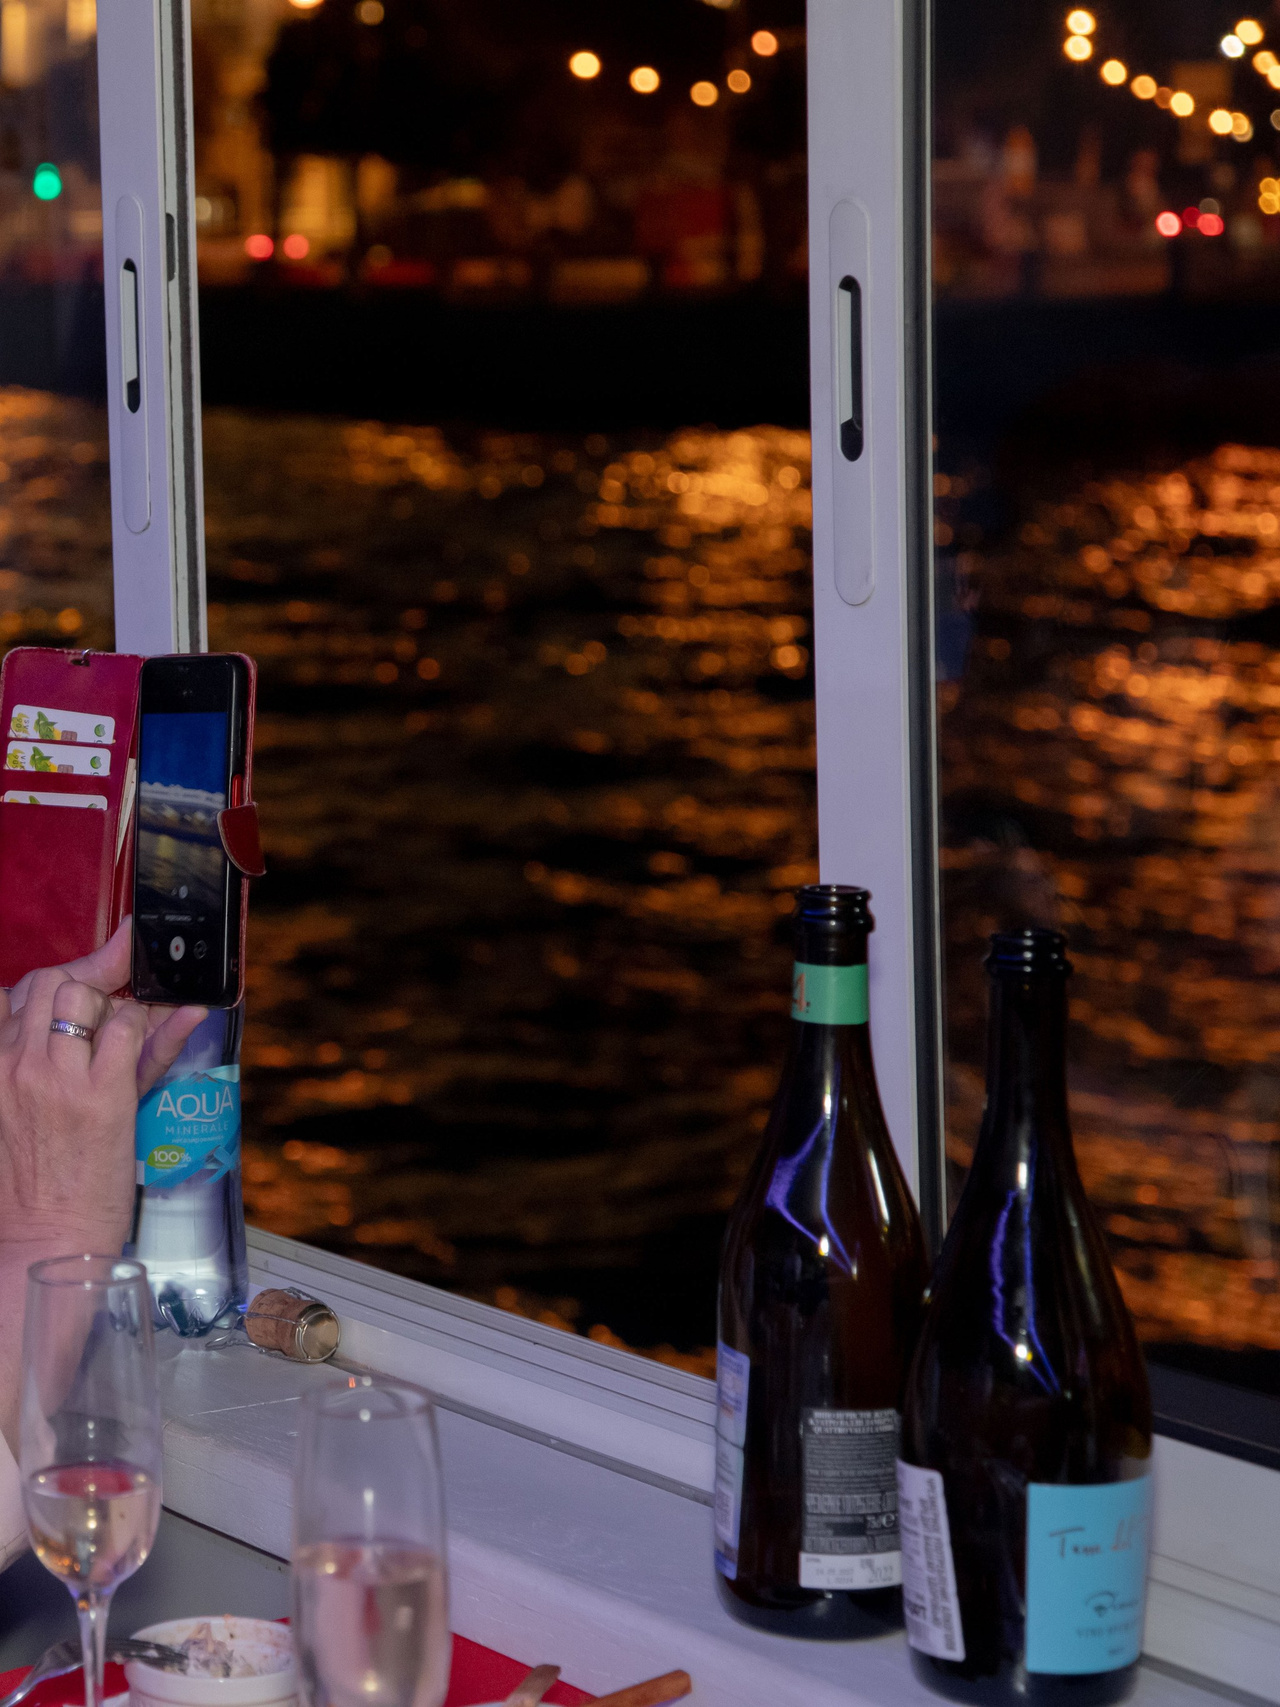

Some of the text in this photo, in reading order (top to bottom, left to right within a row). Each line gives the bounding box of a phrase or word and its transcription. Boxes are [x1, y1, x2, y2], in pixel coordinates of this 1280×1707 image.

[156, 1085, 234, 1123] AQUA
[165, 1120, 229, 1136] MINERALE
[153, 1150, 192, 1163] 100%
